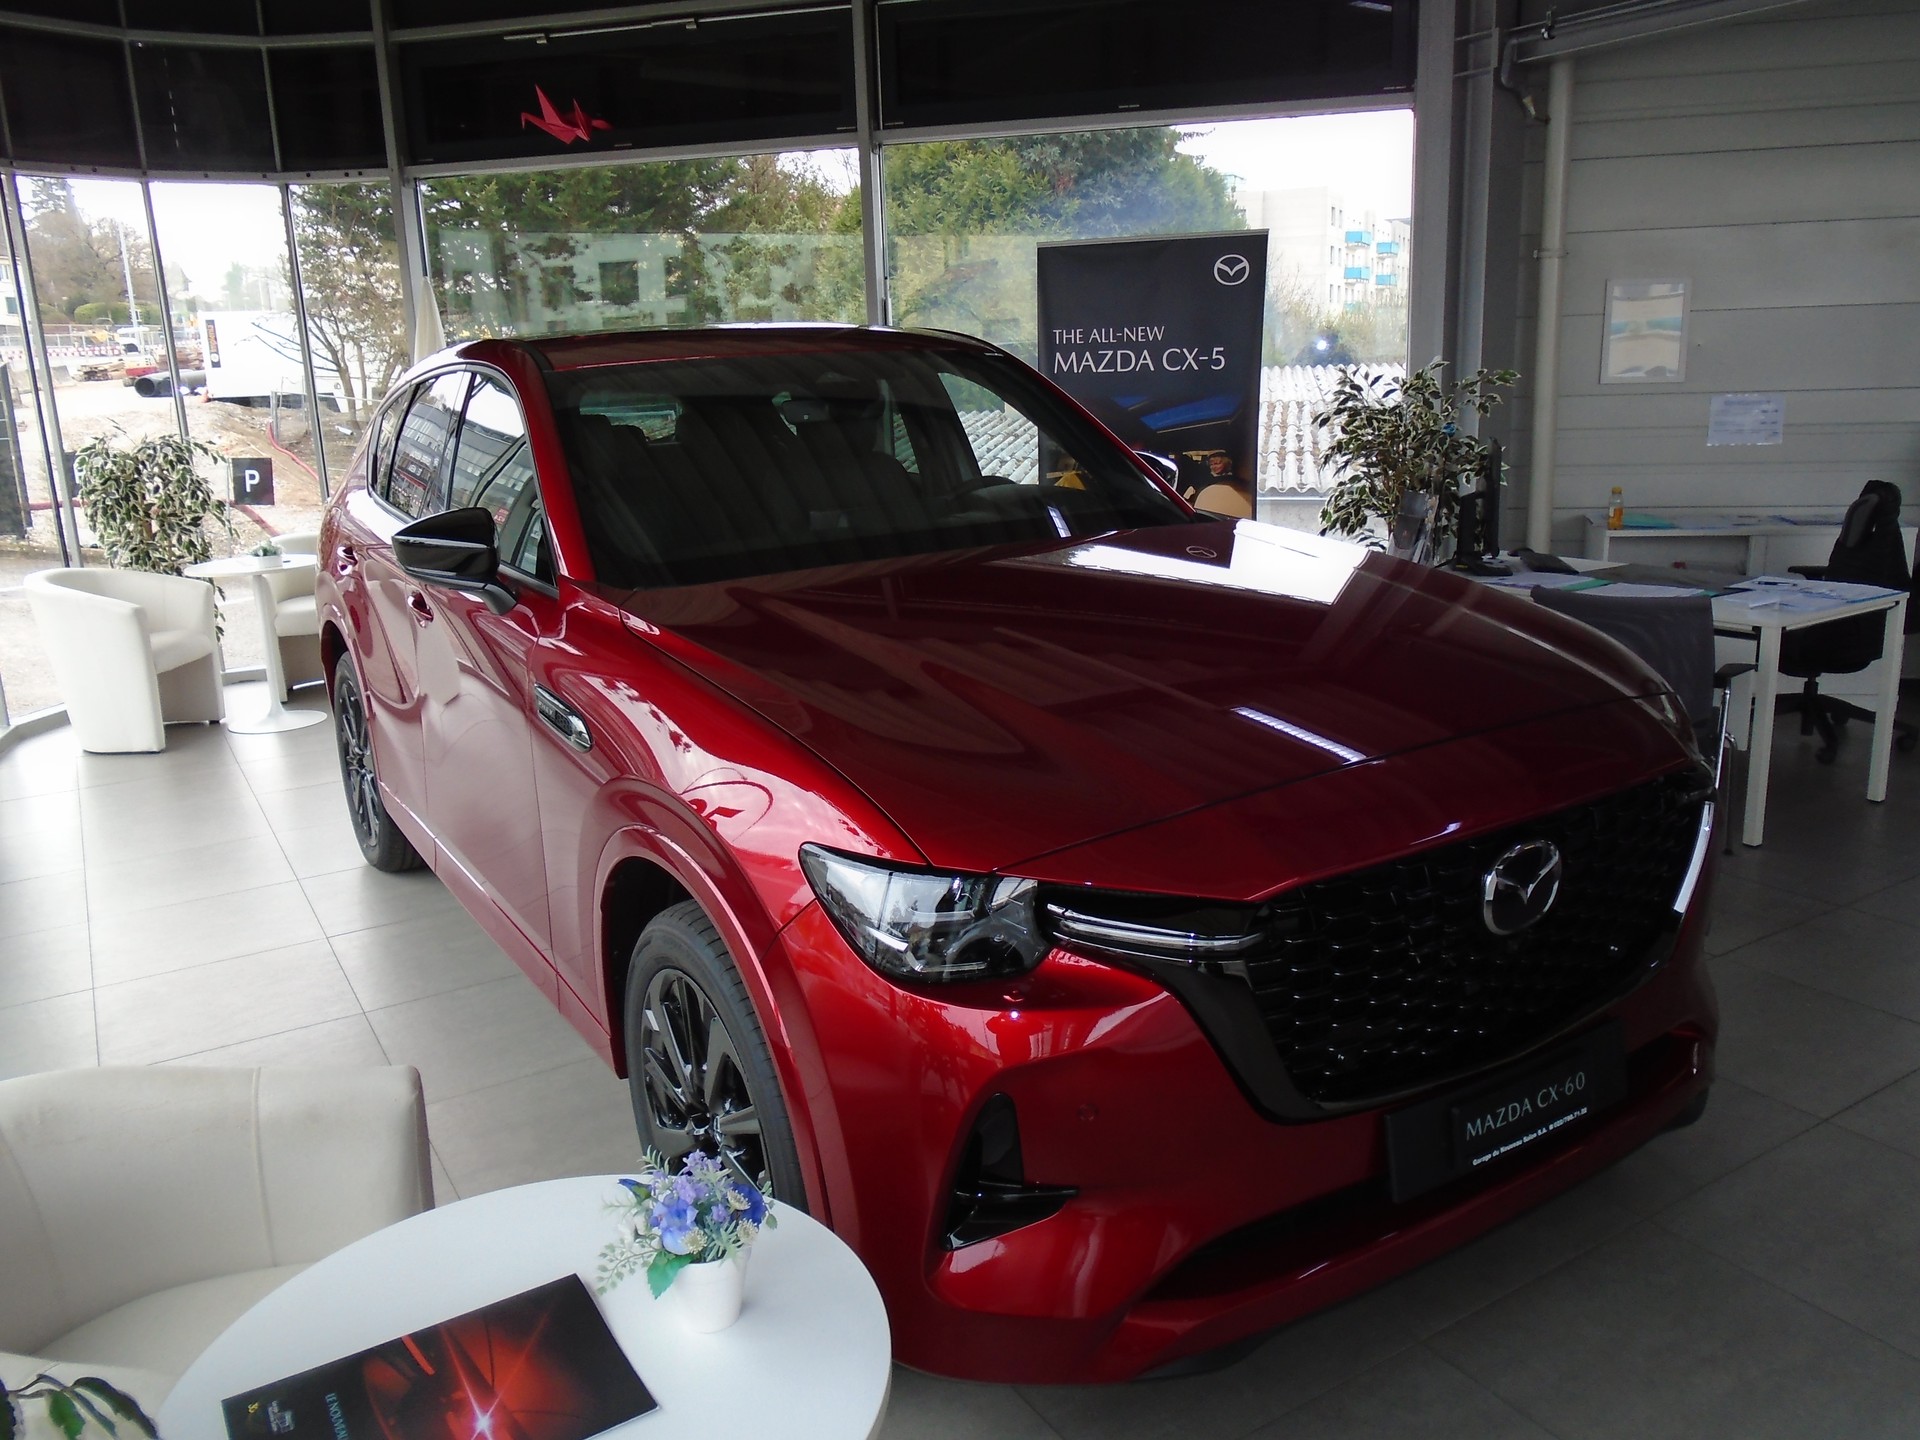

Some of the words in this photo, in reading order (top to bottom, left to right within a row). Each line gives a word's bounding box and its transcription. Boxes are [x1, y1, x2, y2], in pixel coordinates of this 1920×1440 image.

[1053, 329, 1084, 345] THE
[1089, 326, 1165, 344] ALL-NEW
[1054, 349, 1154, 374] MAZDA
[1162, 347, 1226, 371] CX-5
[244, 469, 260, 492] P
[1466, 1098, 1532, 1141] MAZDA
[1537, 1071, 1585, 1108] CX-60
